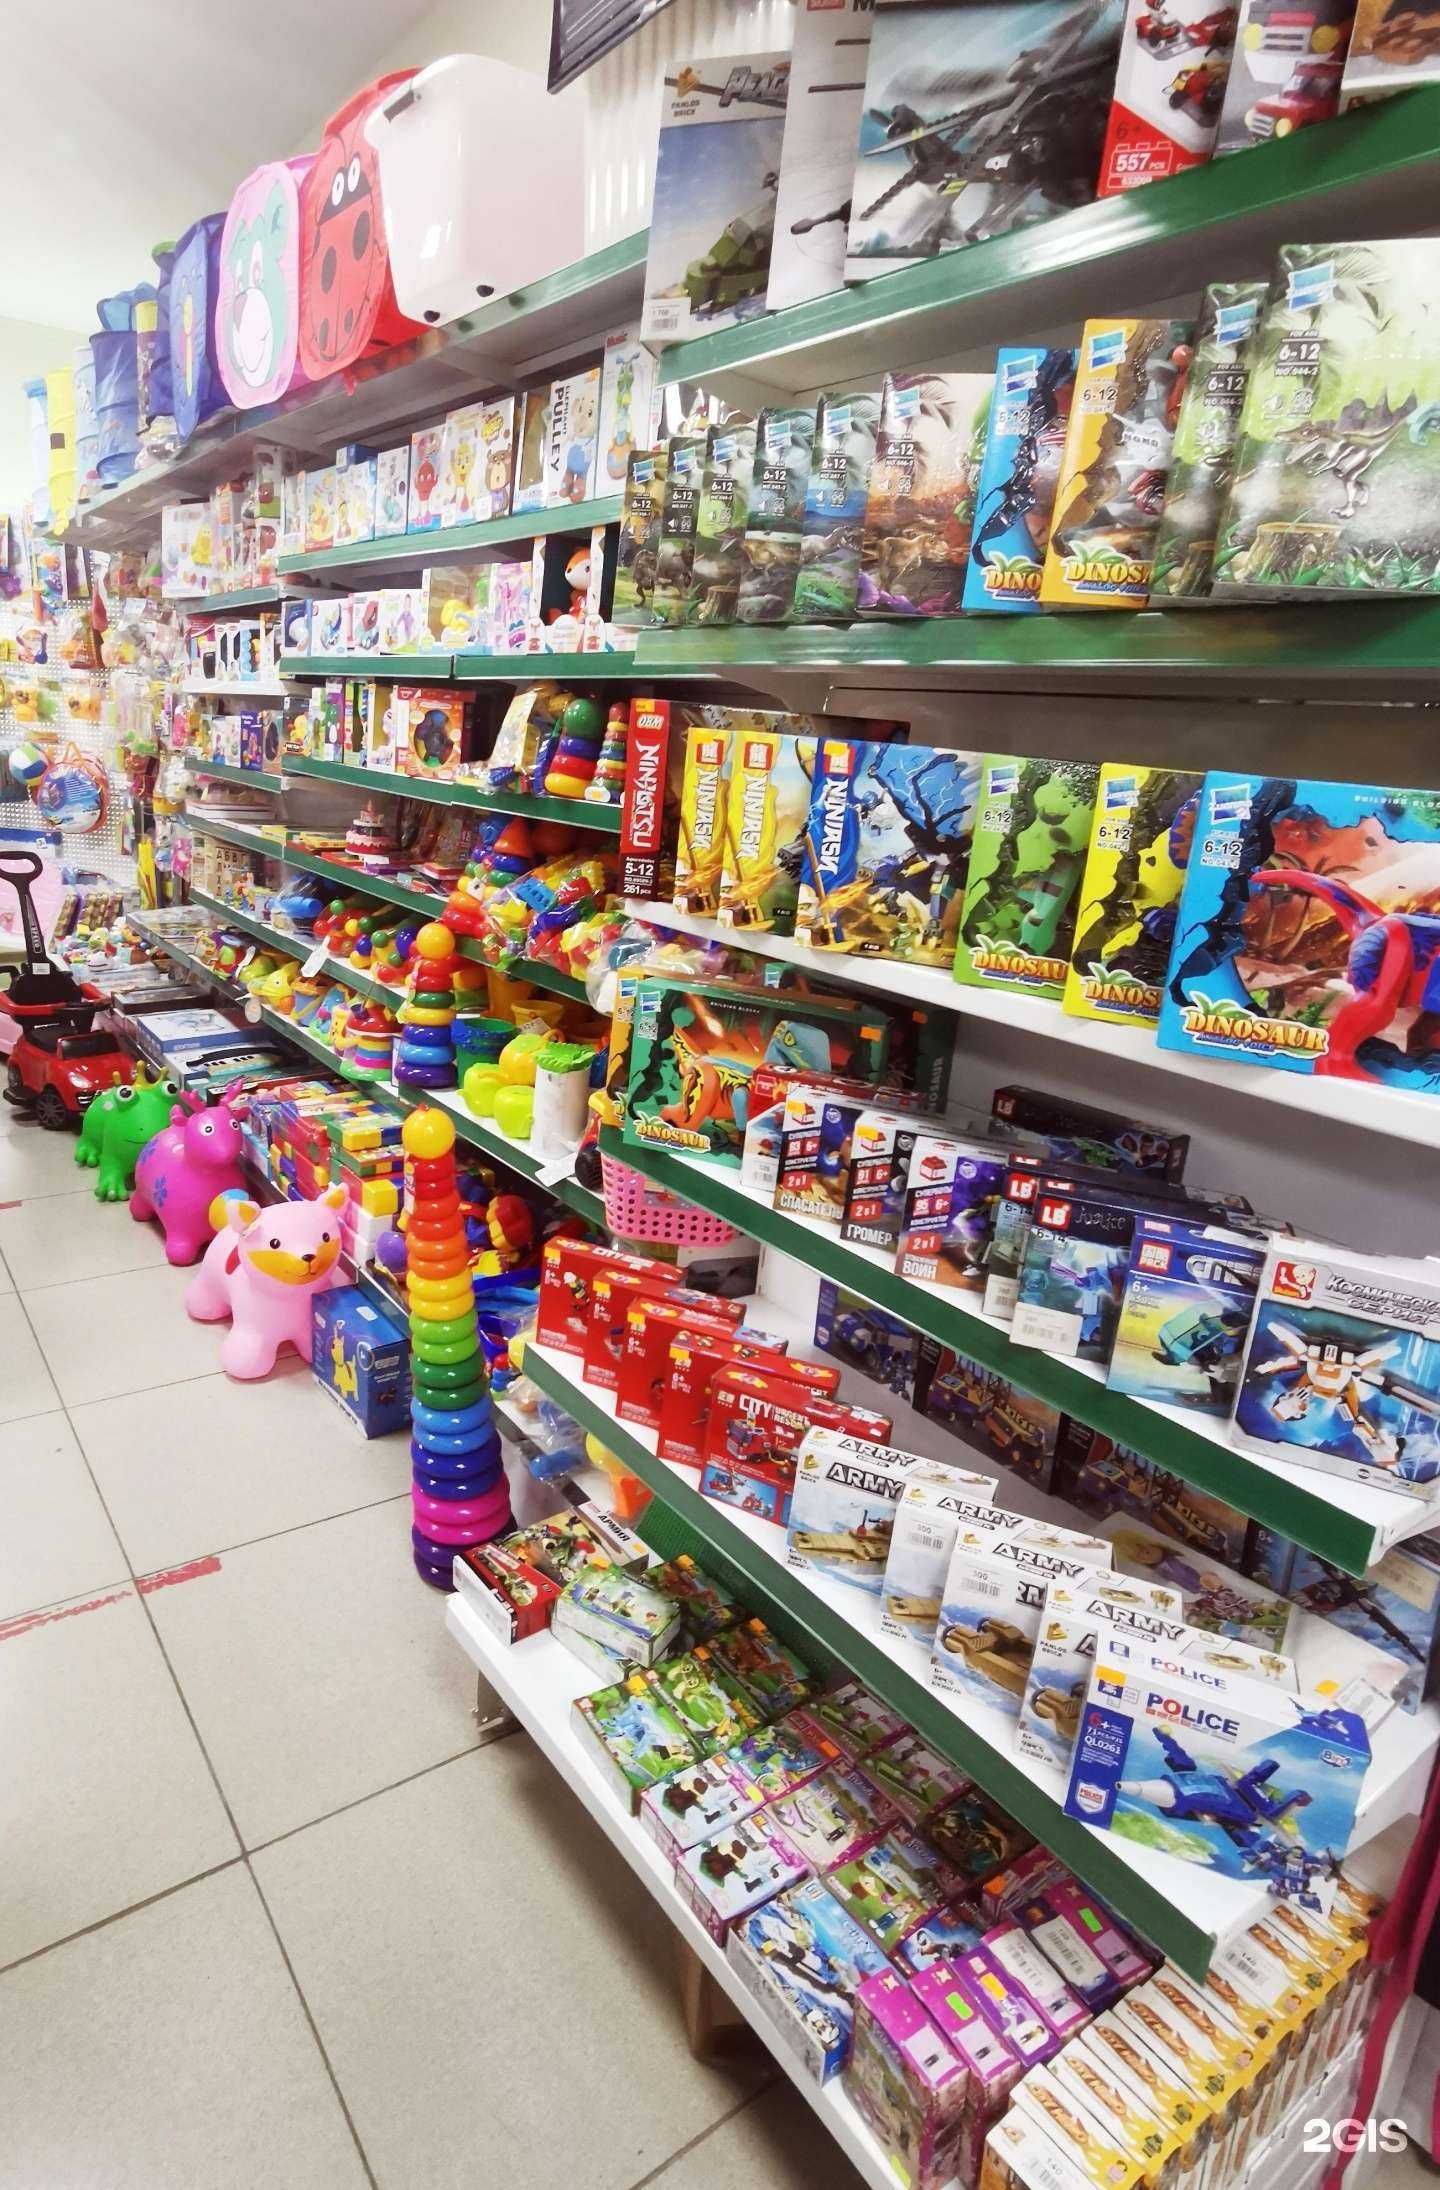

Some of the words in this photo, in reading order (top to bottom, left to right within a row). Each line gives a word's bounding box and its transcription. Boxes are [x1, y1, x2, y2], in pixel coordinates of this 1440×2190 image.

[1115, 153, 1152, 172] 557
[1280, 343, 1321, 360] 6-12
[1207, 376, 1245, 391] 6-12
[1083, 386, 1119, 401] 6-12
[551, 386, 565, 472] PULLEY
[887, 443, 914, 456] 6-12
[822, 458, 847, 470] 6-12
[763, 470, 787, 481] 6-12
[711, 482, 733, 492] 6-12
[631, 500, 652, 509] 6-12
[672, 491, 693, 501] 6-12
[984, 810, 1013, 823] 6-12
[1099, 826, 1131, 840] 6-12
[1204, 839, 1241, 856] 6-12
[624, 863, 654, 877] 5-12
[623, 884, 640, 894] 261
[975, 951, 1066, 980] DINOSAU
[1186, 1011, 1326, 1050] DINOSAUR
[637, 1124, 711, 1149] DINOSAUR
[788, 1175, 795, 1187] 2
[876, 1168, 888, 1179] 6+
[1010, 1180, 1033, 1199] LB
[855, 1205, 862, 1217] 2
[935, 1198, 949, 1210] 6+
[1042, 1205, 1068, 1226] LB
[846, 1223, 893, 1245] ГРОМЕР
[912, 1237, 920, 1250] 2
[928, 1236, 935, 1248] 1
[902, 1260, 937, 1280] ВОИН
[1132, 1280, 1150, 1293] 6+
[1347, 1296, 1431, 1326] СЕРИЯ
[672, 1372, 685, 1383] 6+
[739, 1393, 773, 1418] CITY
[838, 1438, 918, 1467] ARMY
[826, 1462, 905, 1502] ARMY
[936, 1496, 1024, 1529] ARMY
[598, 1515, 631, 1542] АРМИЯ
[993, 1542, 1086, 1578] ARMY
[1086, 1600, 1186, 1641] ARMY
[1151, 1657, 1229, 1690] POLICE
[1147, 1692, 1241, 1738] POLICE
[1084, 1735, 1121, 1755] QL0261
